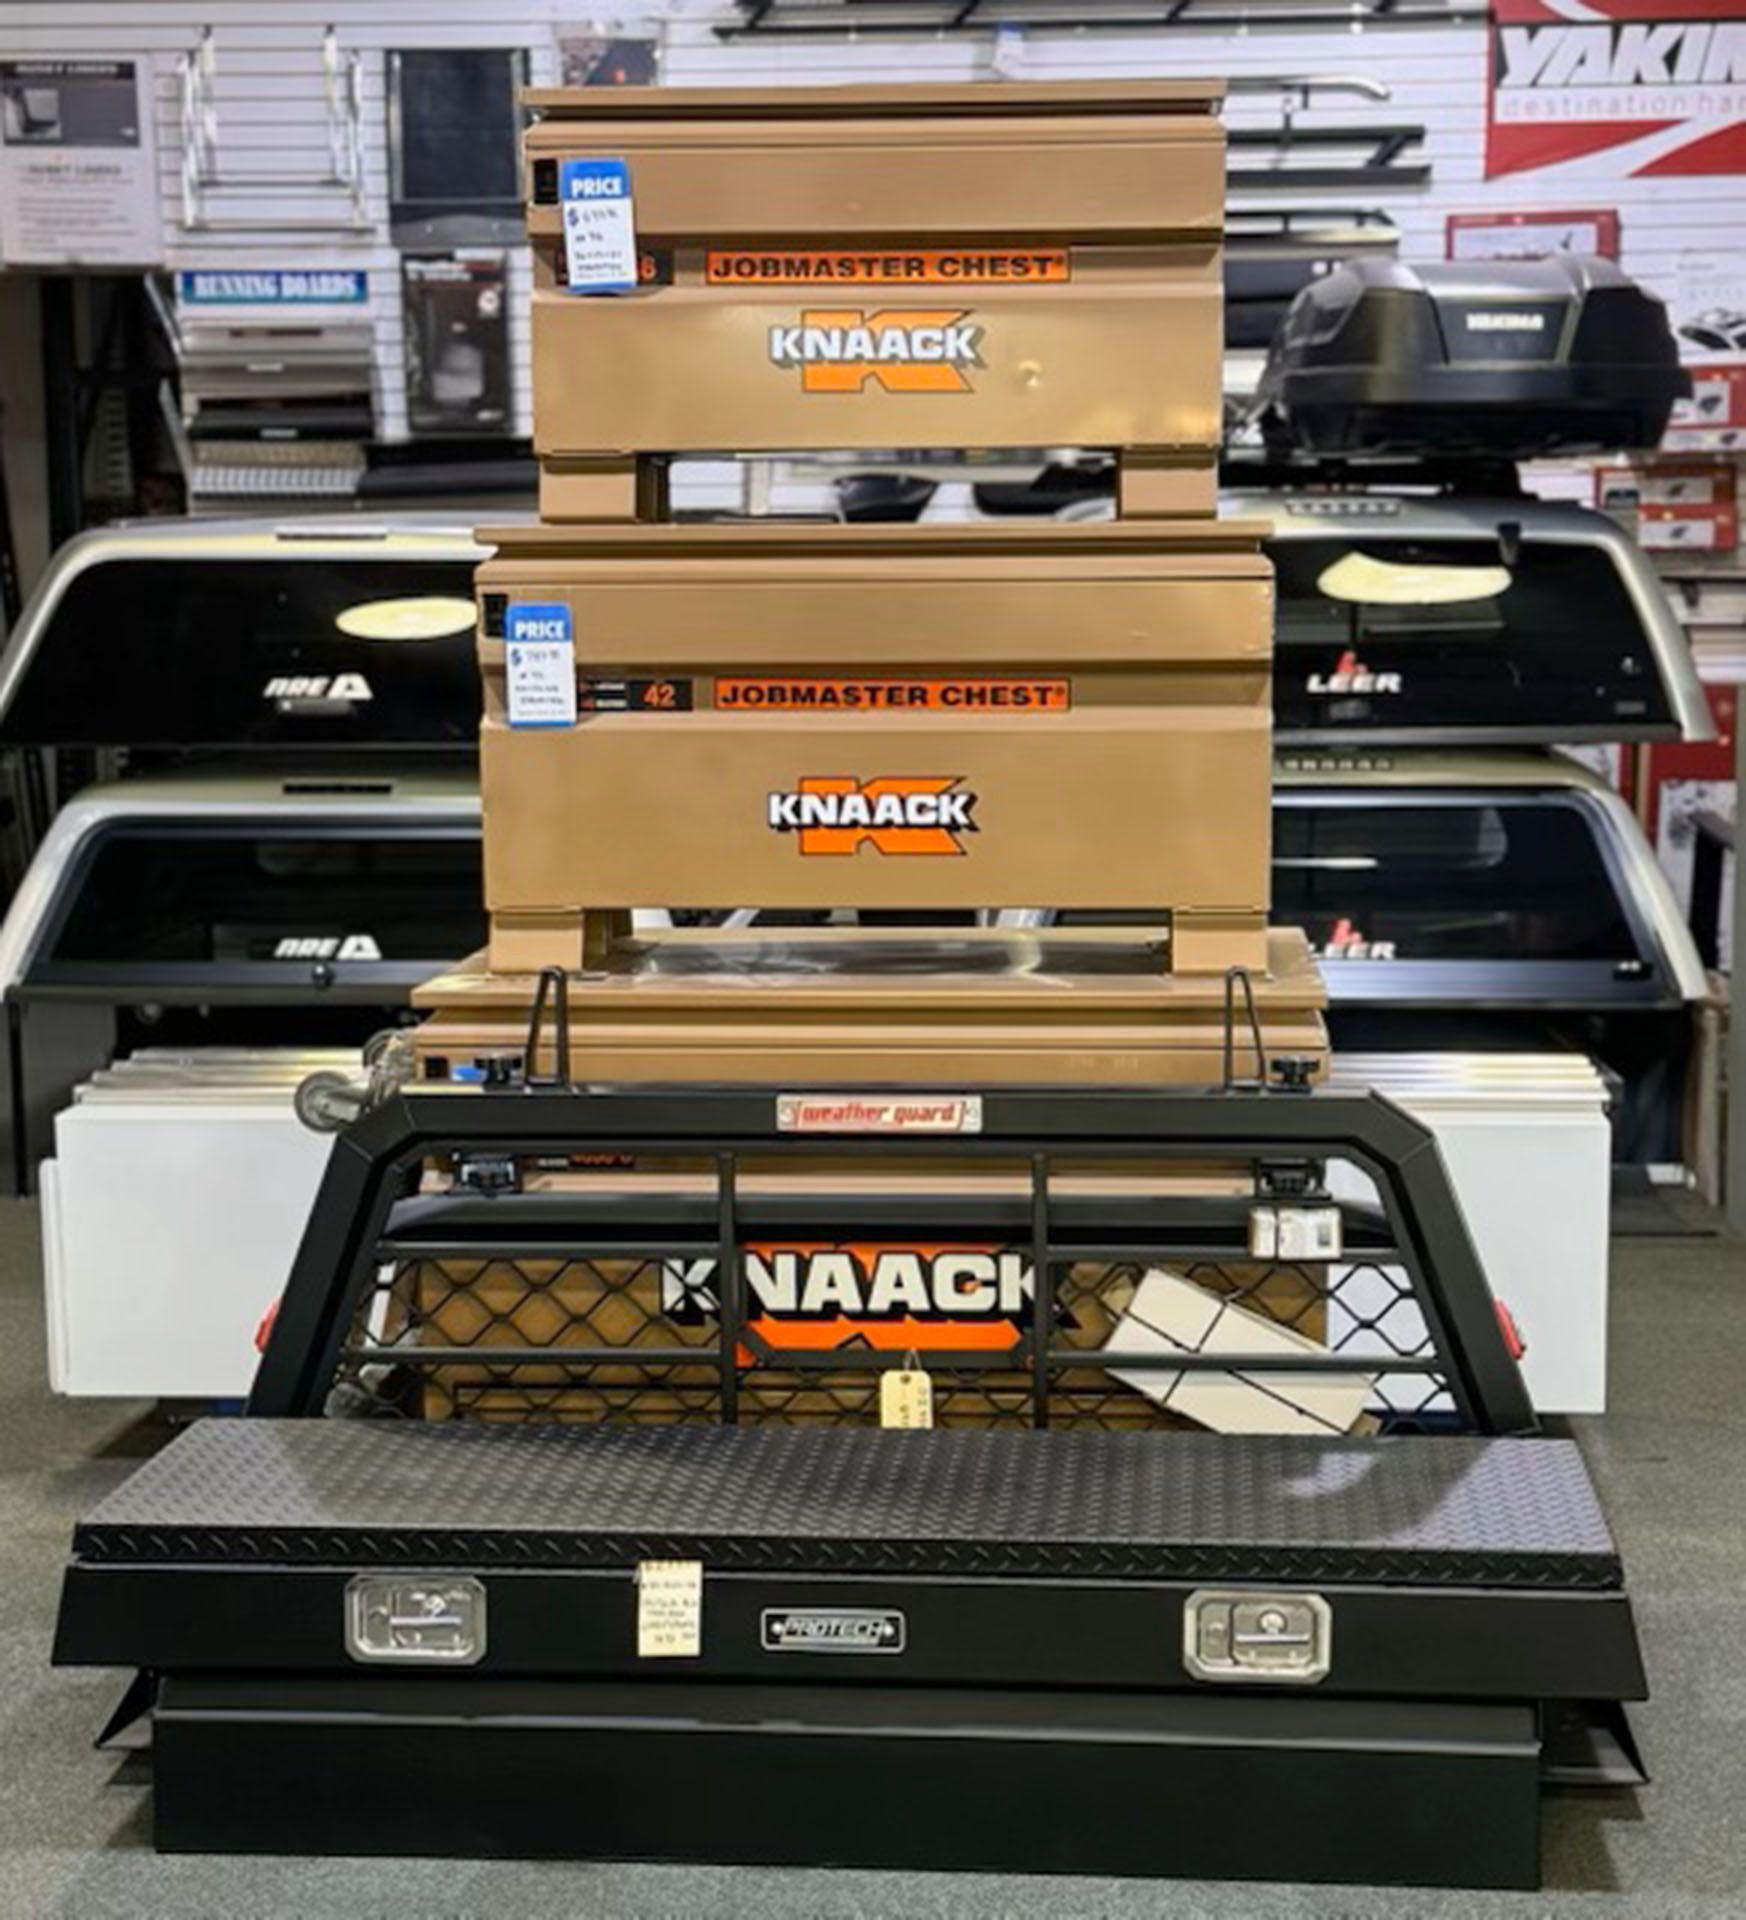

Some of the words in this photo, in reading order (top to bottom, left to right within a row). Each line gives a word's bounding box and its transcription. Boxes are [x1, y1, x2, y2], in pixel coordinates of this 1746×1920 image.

[1504, 94, 1687, 118] destination
[571, 176, 622, 198] PRICE
[714, 257, 926, 279] JOBMASTER
[194, 273, 279, 299] RUNNING
[281, 273, 357, 299] BOARDS
[770, 325, 984, 367] KNAACK
[515, 618, 565, 639] PRICE
[1306, 673, 1402, 693] LEER
[643, 683, 676, 708] 42
[721, 685, 929, 706] JOBMASTER
[767, 792, 979, 832] KNAACK
[803, 1102, 890, 1123] weather
[892, 1102, 957, 1127] guard
